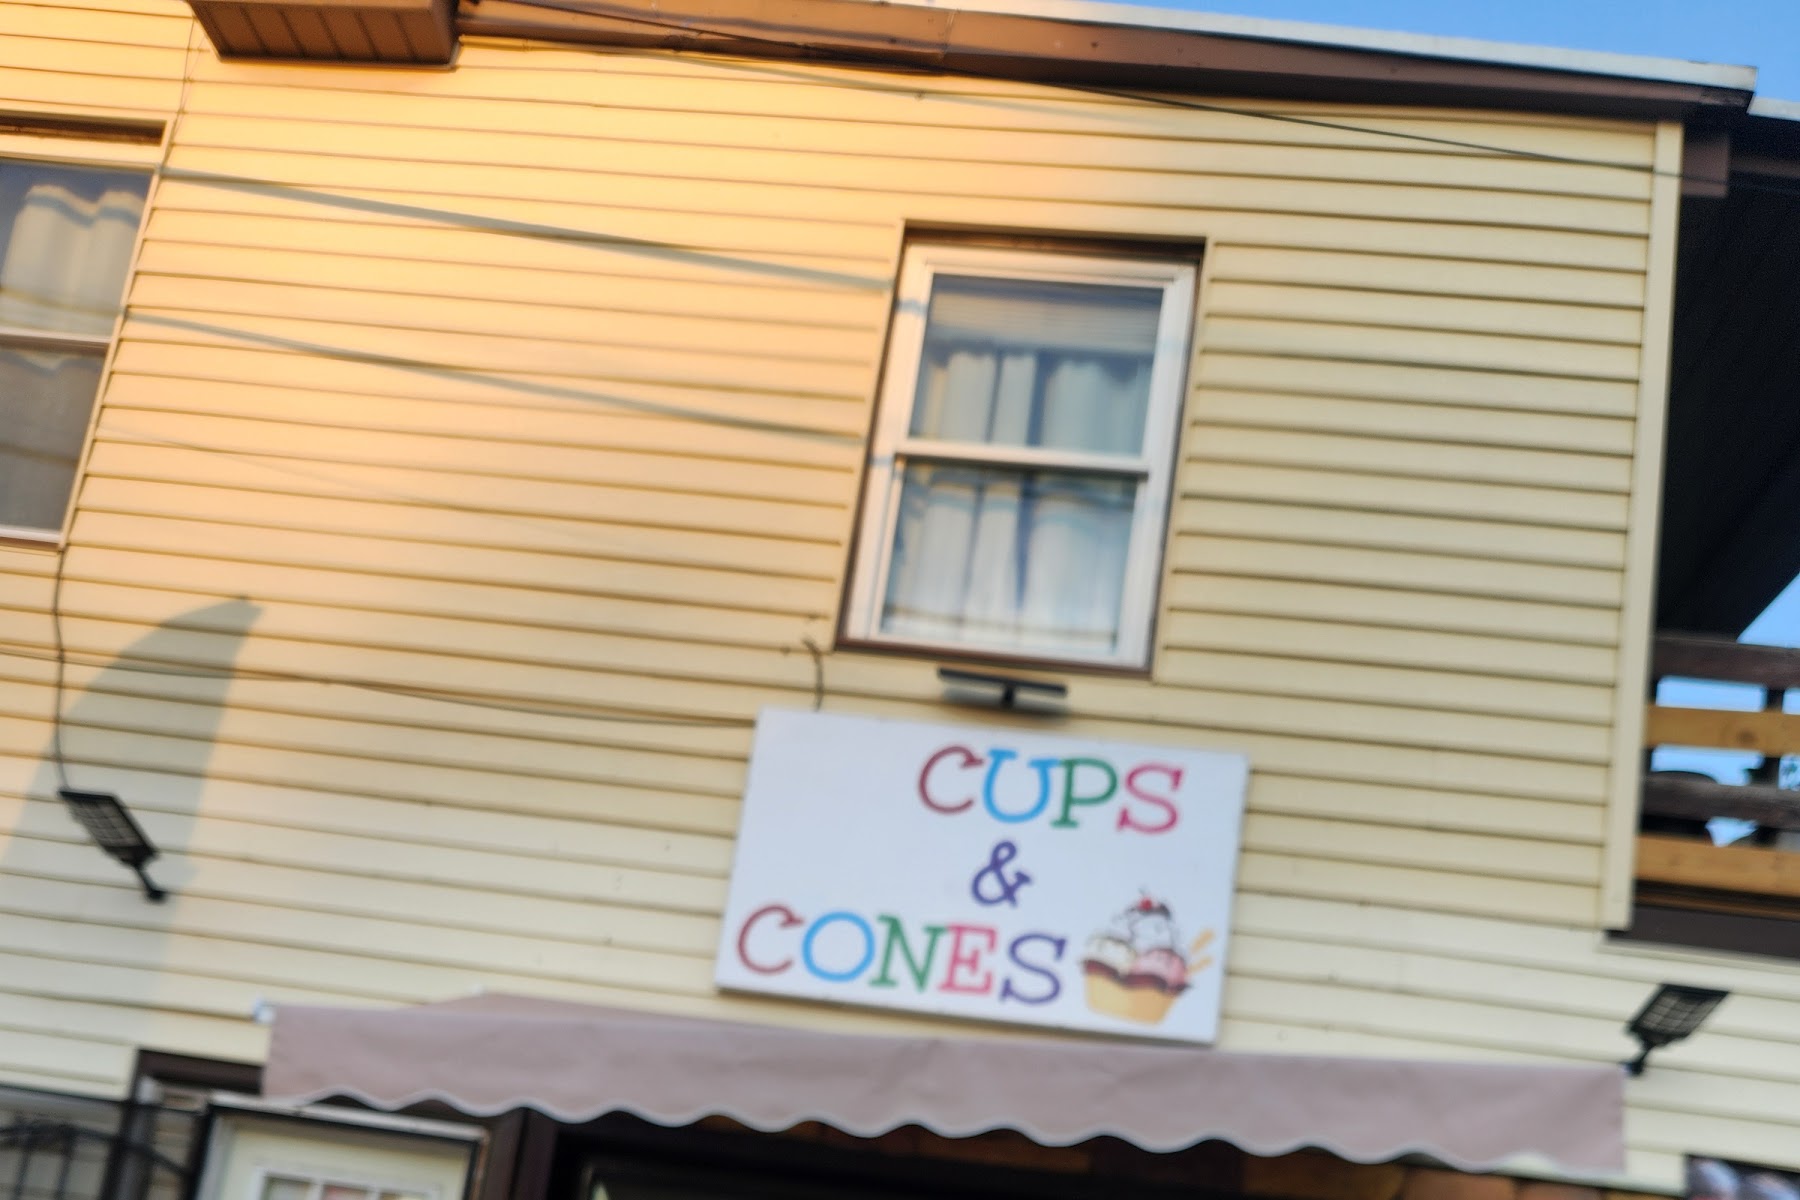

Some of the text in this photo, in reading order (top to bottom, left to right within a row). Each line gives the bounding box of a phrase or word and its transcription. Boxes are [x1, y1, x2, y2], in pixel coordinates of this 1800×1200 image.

[919, 746, 1183, 833] CUPS
[971, 841, 1032, 907] &
[738, 905, 1066, 1004] CONES
